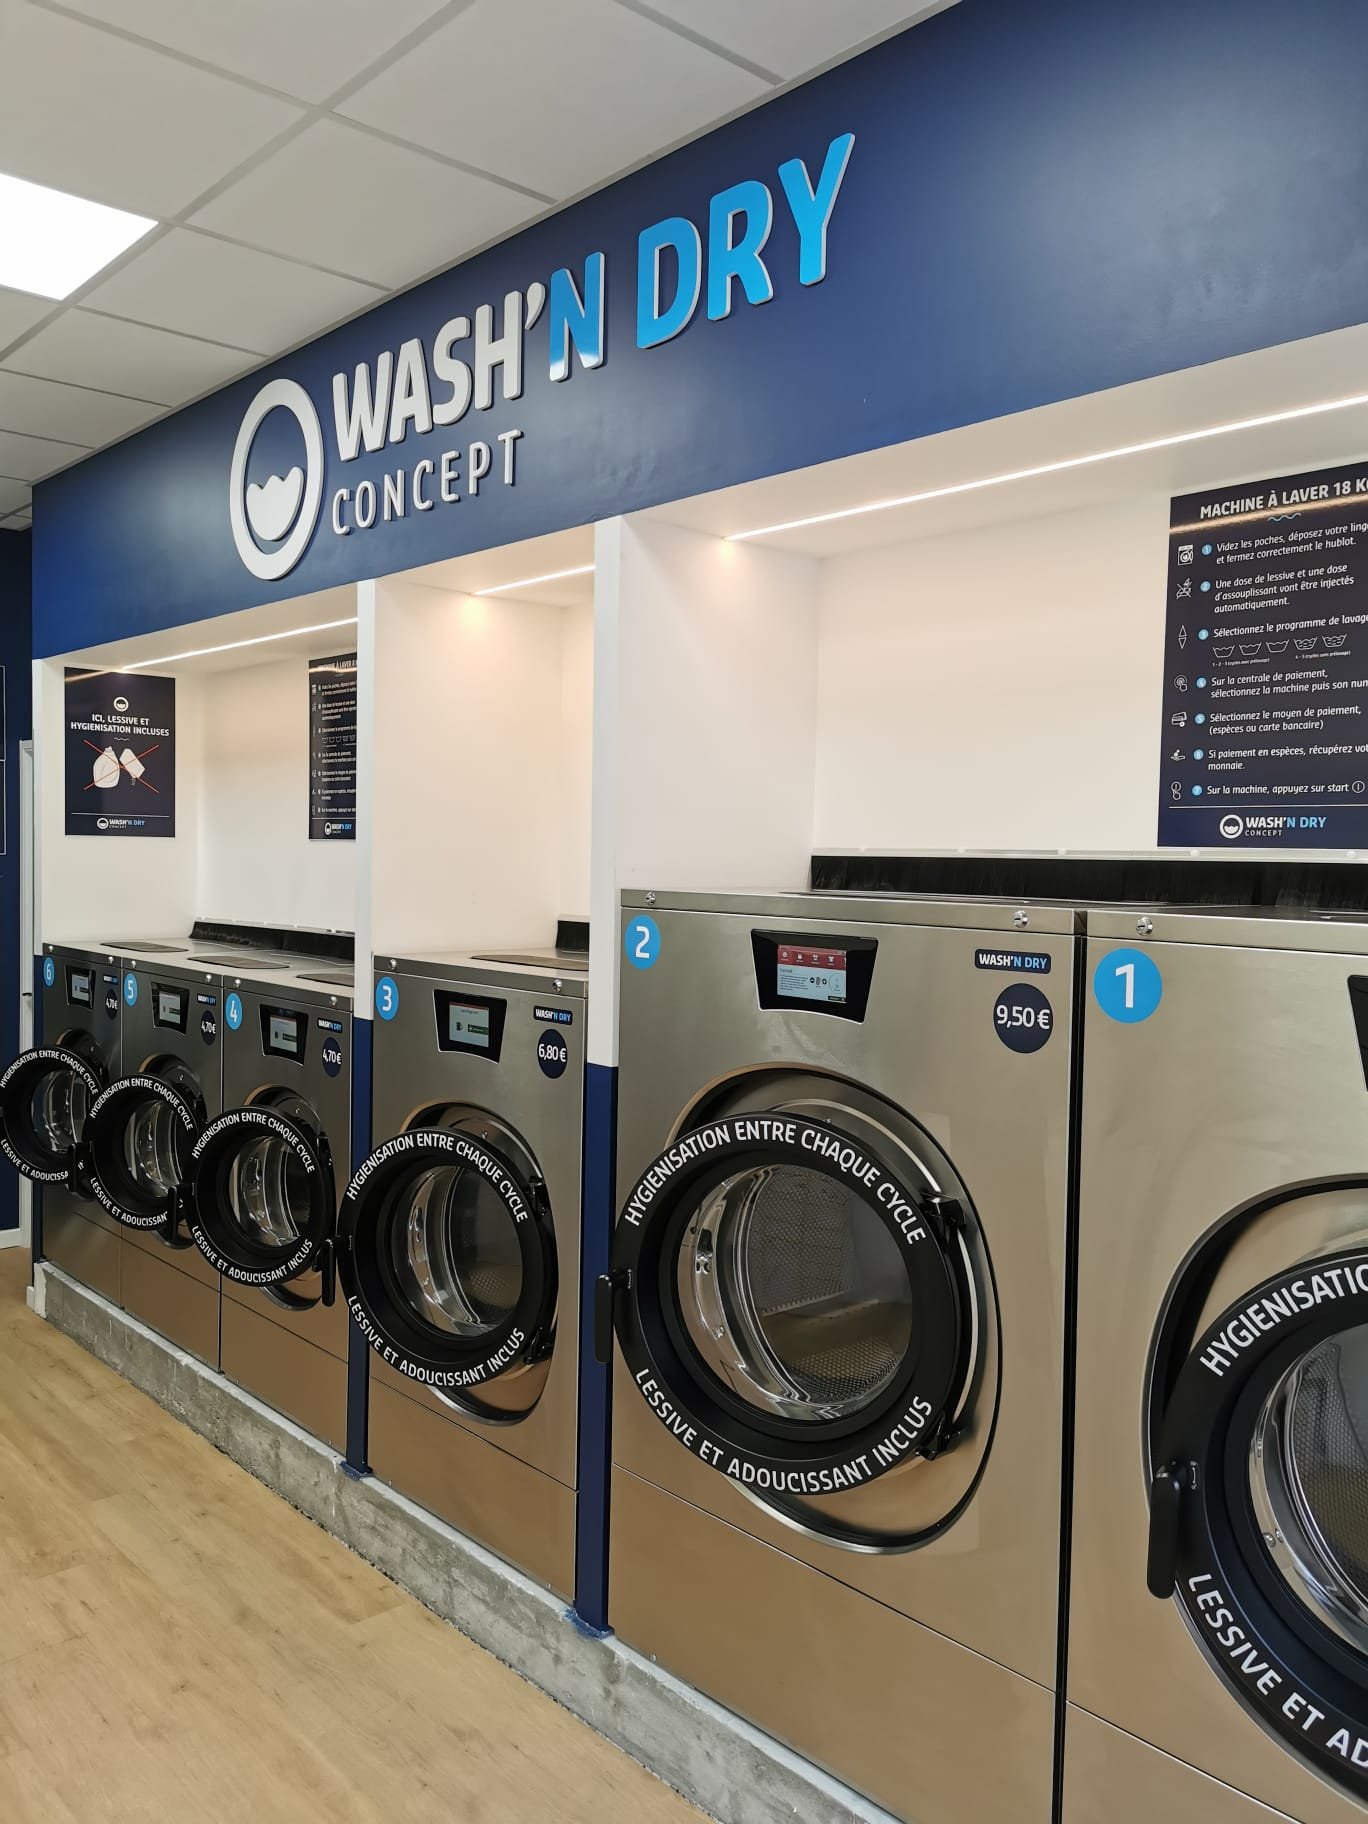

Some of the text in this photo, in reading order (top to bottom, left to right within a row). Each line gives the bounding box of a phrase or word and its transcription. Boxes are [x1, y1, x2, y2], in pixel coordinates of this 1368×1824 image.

[332, 132, 855, 462] WASH'N DRY
[331, 428, 524, 536] CONCEPT
[1200, 478, 1368, 519] MACHINE À LAVER 18 K
[1217, 540, 1238, 552] Videz
[1241, 538, 1252, 548] les
[1255, 535, 1286, 548] poches,
[1288, 530, 1323, 545] déposez
[1325, 524, 1348, 536] votre
[1216, 537, 1357, 564] et fermez correctement le hublot.
[1216, 580, 1231, 589] Une
[1233, 576, 1252, 586] dose
[1255, 574, 1264, 584] de
[1267, 570, 1295, 582] lessive
[1297, 570, 1306, 578] et
[1308, 569, 1324, 577] une
[1327, 565, 1348, 574] dose
[1280, 584, 1299, 593] vont
[1301, 580, 1318, 591] être
[1321, 576, 1354, 588] injectés
[1214, 597, 1290, 613] automatiquement.
[1213, 625, 1264, 638] Sélectionnez
[1267, 622, 1273, 631] le
[1276, 618, 1326, 634] programme
[1329, 615, 1339, 624] de
[1211, 677, 1226, 687] Sur
[1227, 676, 1235, 684] la
[1237, 673, 1271, 684] centrale
[1273, 672, 1283, 681] de
[1285, 669, 1328, 684] paiement,
[1211, 678, 1368, 698] sélectionnez la machine puis son num
[92, 714, 105, 723] ICI,
[107, 715, 138, 725] LESSIVE
[1209, 710, 1260, 722] Sélectionnez
[1263, 710, 1270, 720] le
[1273, 710, 1302, 722] moyen
[1303, 708, 1315, 717] de
[1317, 706, 1361, 720] paiement,
[71, 722, 169, 736] HYGIENISATION INCLUSES
[1209, 720, 1324, 736] (espèces ou carte bancaire)
[1208, 750, 1216, 759] Si
[1218, 749, 1256, 762] paiement
[1258, 749, 1268, 757] en
[1270, 747, 1306, 758] espèces,
[1309, 744, 1352, 756] récupérez
[1208, 761, 1245, 771] monnaie.
[1207, 786, 1221, 795] Sur
[1223, 785, 1230, 794] la
[1233, 785, 1270, 795] machine,
[1272, 784, 1308, 797] appuyez
[1310, 785, 1325, 793] sur
[1327, 783, 1349, 792] start
[1245, 829, 1282, 837] CONCEPT
[1300, 817, 1327, 827] DRY
[635, 928, 651, 959] 2
[46, 968, 51, 979] 6
[1024, 956, 1048, 971] DRY
[128, 982, 133, 994] 5
[1115, 963, 1135, 1009] 1
[382, 987, 392, 1011] 3
[230, 1000, 237, 1023] 4
[558, 1011, 571, 1023] DRY
[0, 1050, 99, 1095] HYGIENISATION ENTRE CHAQUE CYCLE
[89, 1078, 194, 1131] HYGIENISATION ENTRE CHAQUE CYCLE
[191, 1112, 315, 1174] HYGIENISATION ENTRE CHAQUE CYCLE
[0, 1138, 69, 1181] LESSIVE ET ADOUCISSA
[346, 1132, 528, 1224] HYGIENISATION ENTRE CHAQUE CYCLE
[624, 1120, 927, 1245] HYGIENISATION ENTRE CHAQUE CYCLE
[90, 1177, 168, 1227] LESSIVE ET ADOUCISSAN
[192, 1225, 313, 1283] LESSIVE ET ADOUCISSANT INCLUS
[347, 1295, 525, 1387] LESSIVE ET ADOUCISSANT INCLUS
[635, 1368, 932, 1494] LESSIVE ET ADOUCISSANT INCLUS
[1188, 1573, 1325, 1732] LESSIVE ET
